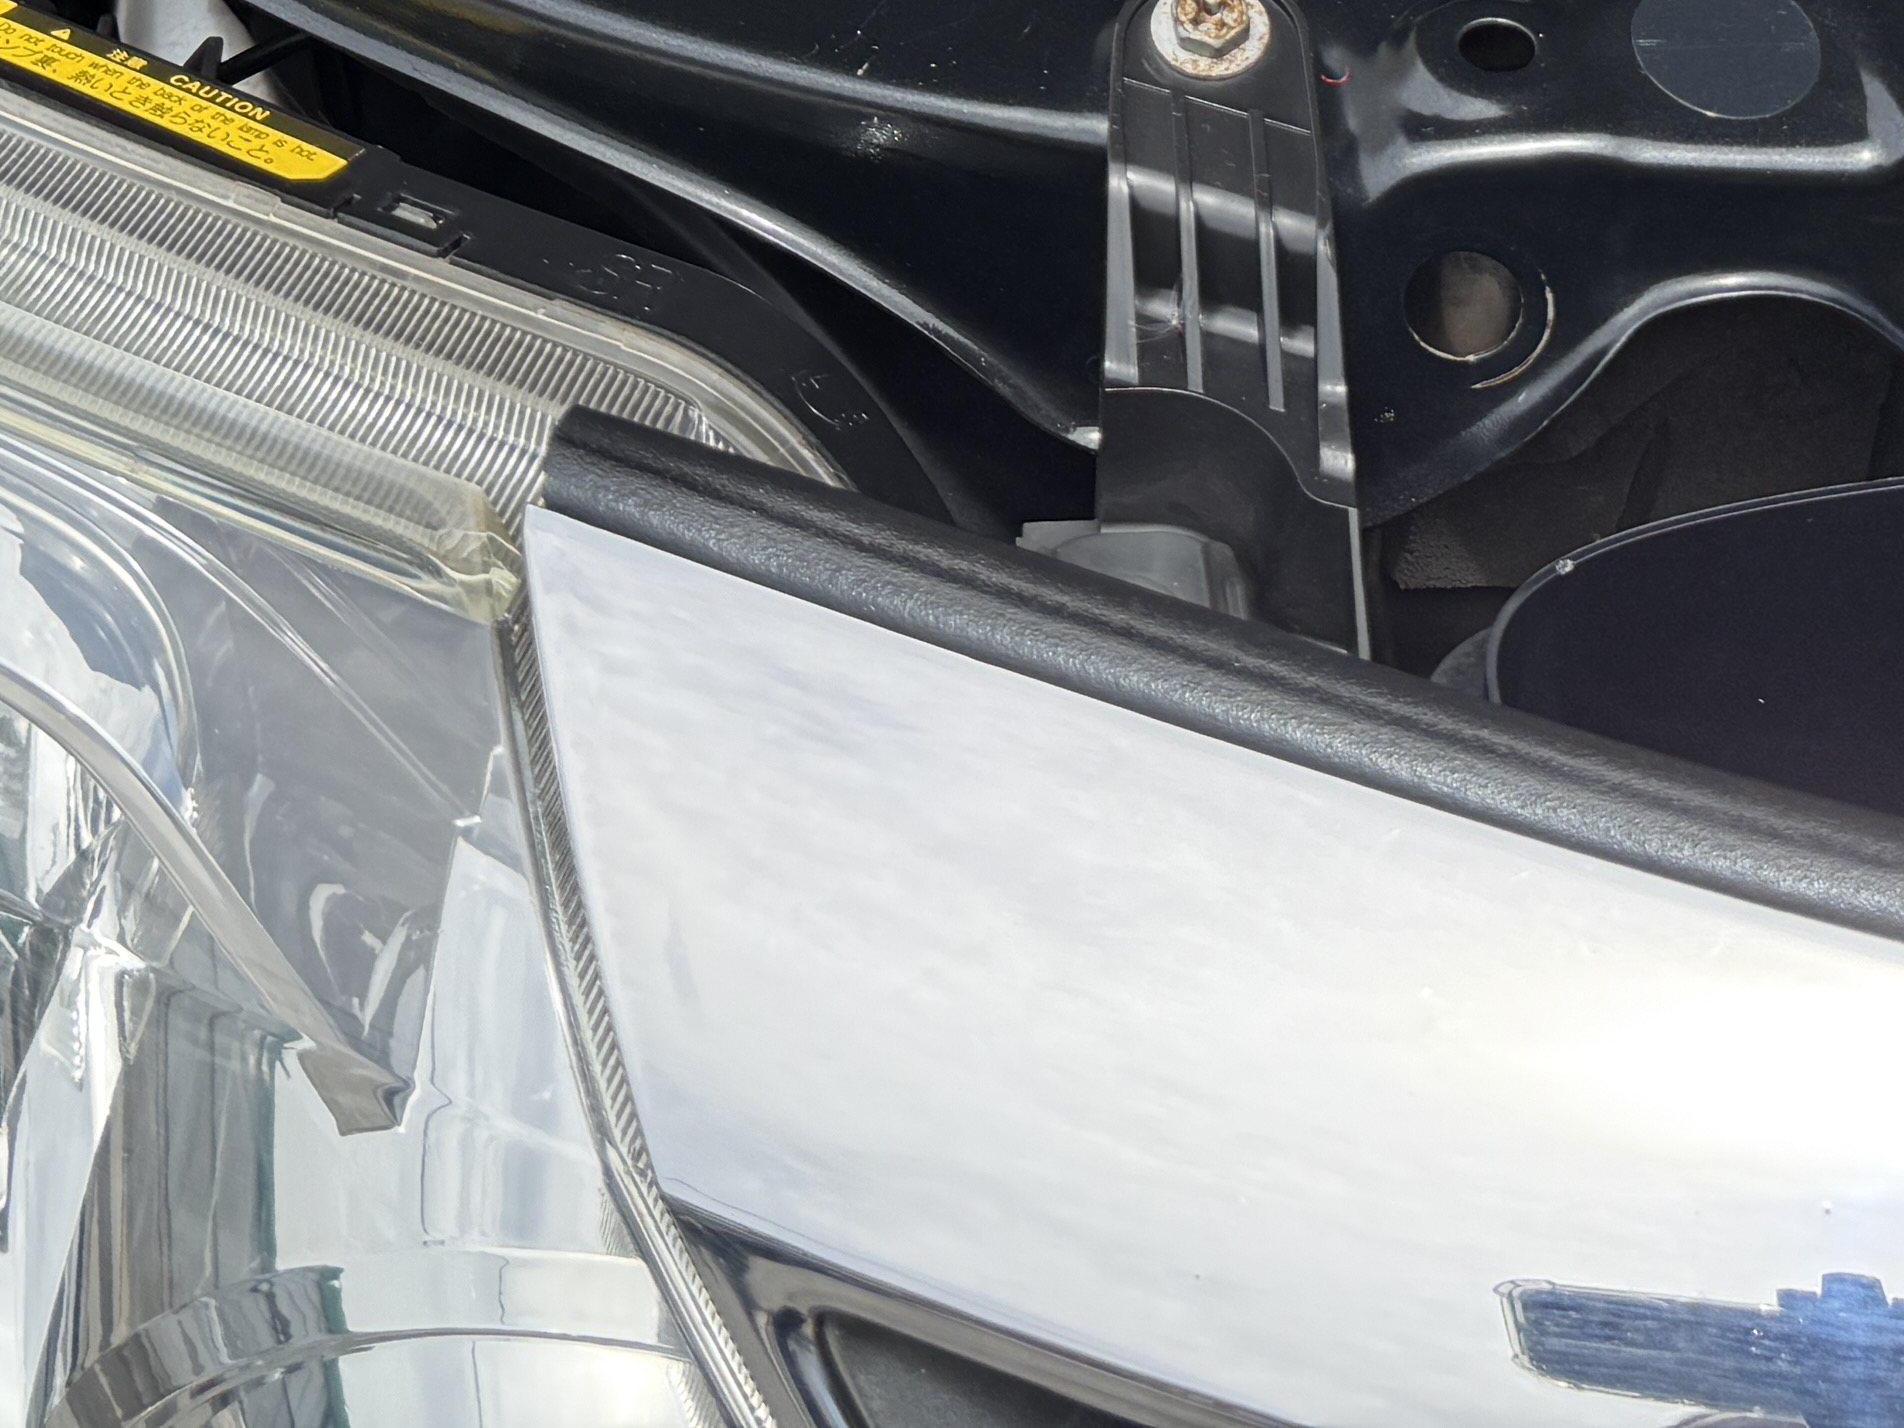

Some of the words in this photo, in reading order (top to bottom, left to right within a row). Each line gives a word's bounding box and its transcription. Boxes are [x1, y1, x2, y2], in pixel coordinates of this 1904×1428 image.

[18, 31, 43, 48] not
[45, 42, 84, 65] touch
[88, 59, 125, 80] when
[127, 76, 151, 91] the
[153, 86, 187, 106] back
[190, 102, 208, 114] of
[211, 111, 235, 125] the
[272, 136, 287, 147] is
[169, 74, 271, 120] CAUTION
